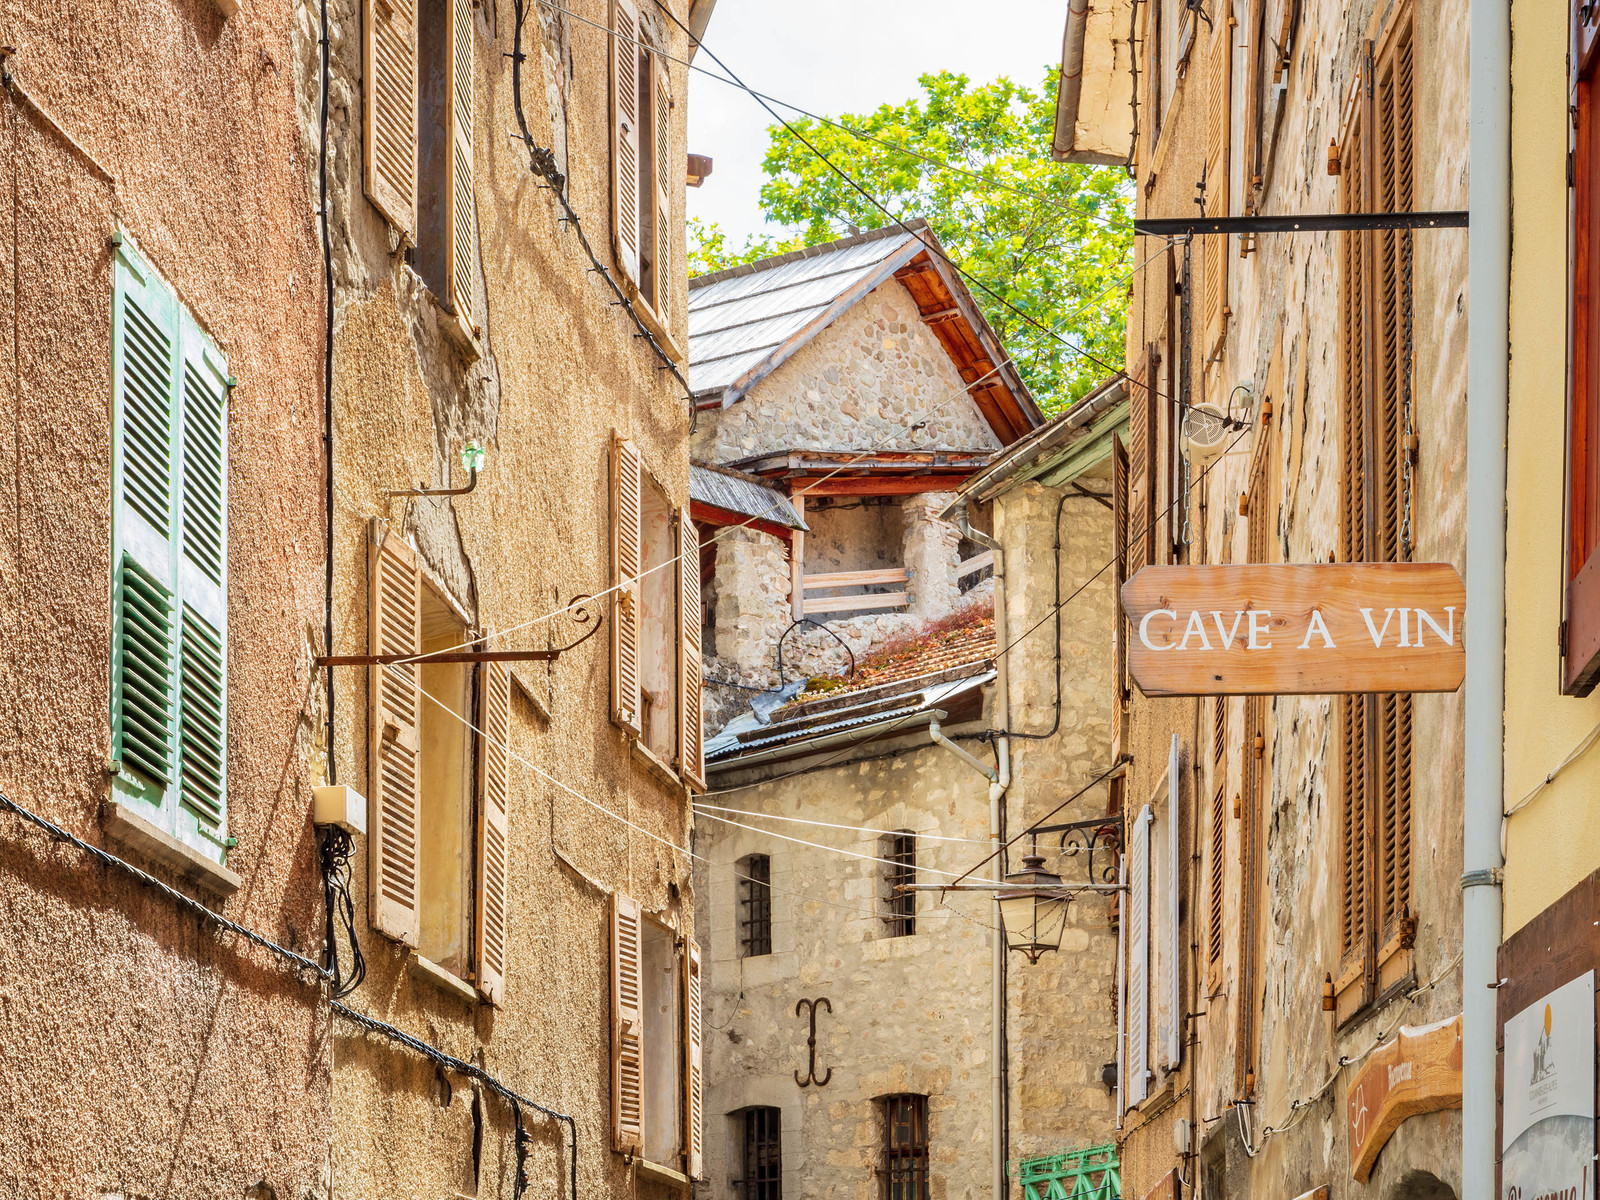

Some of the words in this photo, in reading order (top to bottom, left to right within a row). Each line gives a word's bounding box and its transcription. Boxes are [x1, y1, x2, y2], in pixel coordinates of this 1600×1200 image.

[1139, 609, 1272, 651] CAVE
[1297, 609, 1337, 649] A
[1359, 606, 1457, 649] VIN
